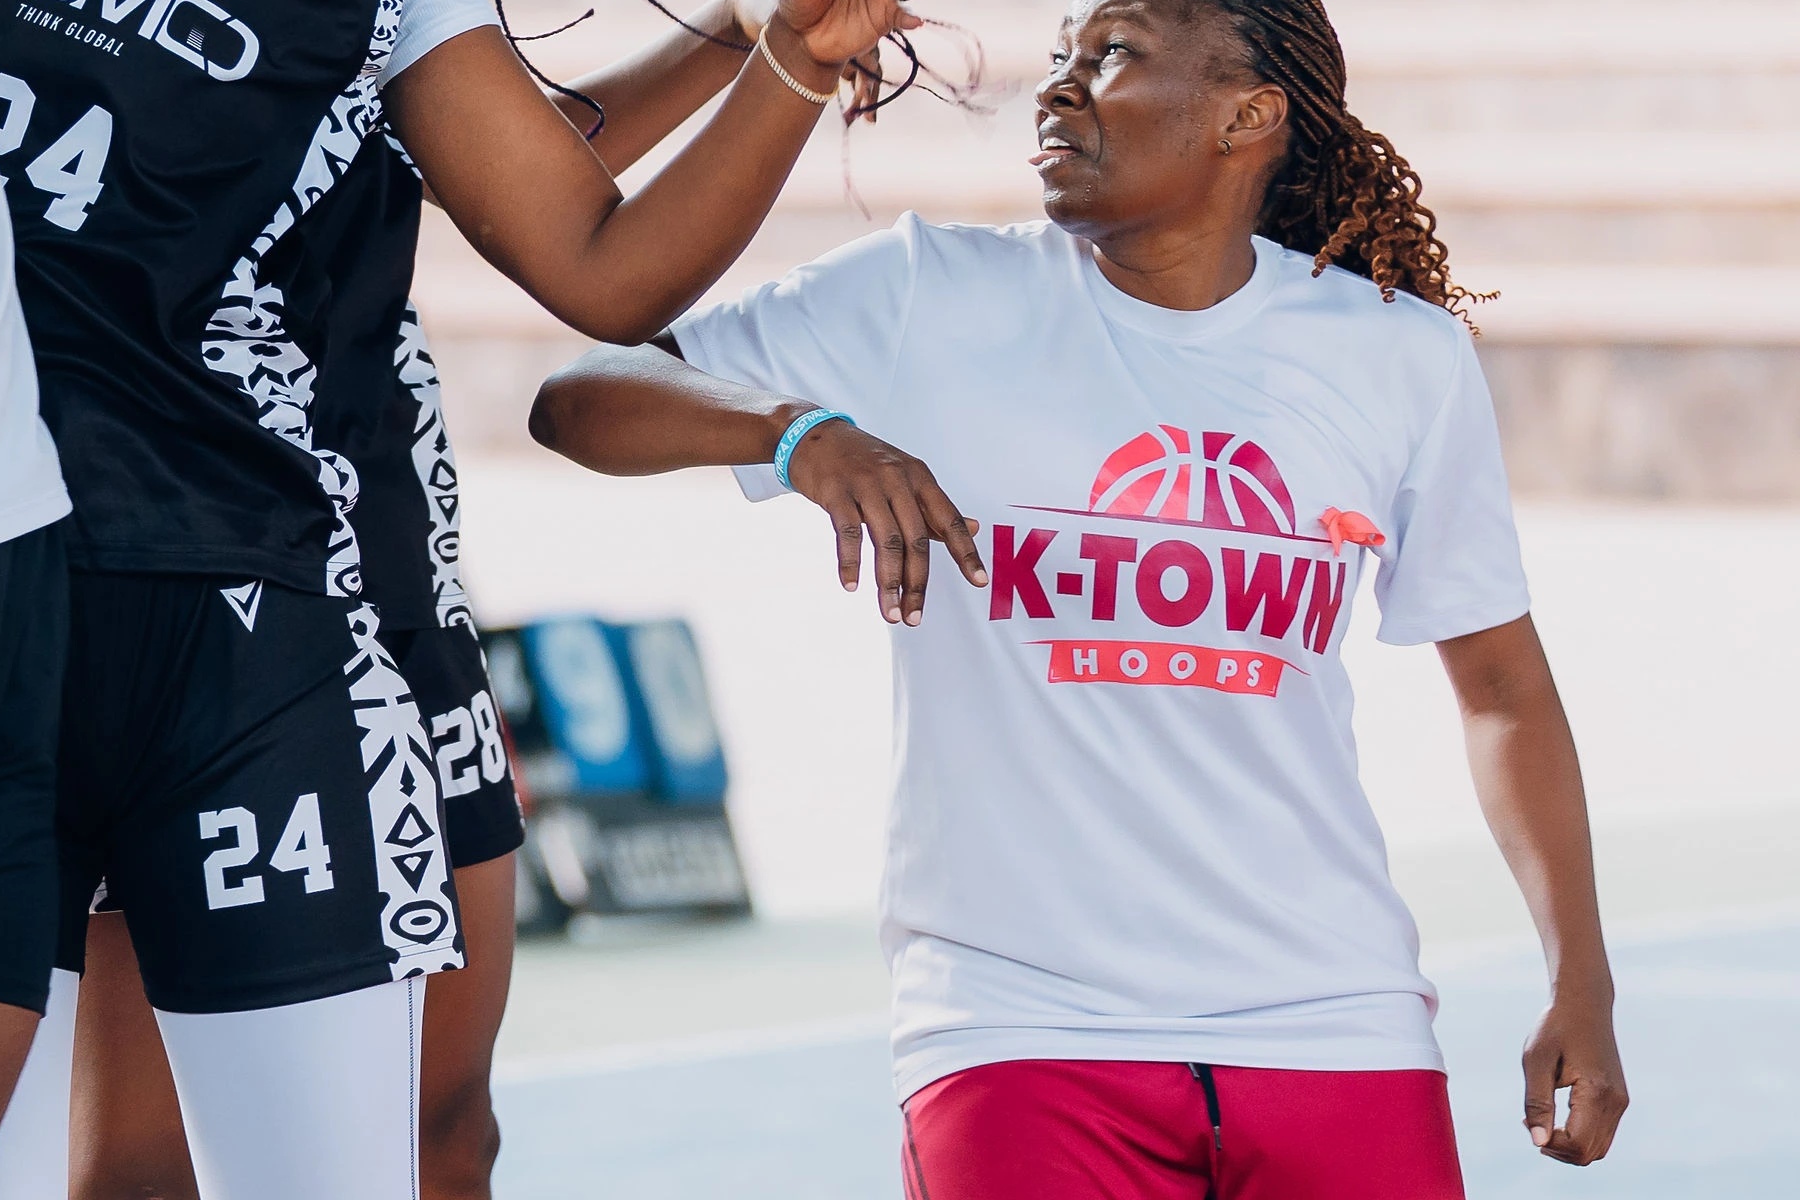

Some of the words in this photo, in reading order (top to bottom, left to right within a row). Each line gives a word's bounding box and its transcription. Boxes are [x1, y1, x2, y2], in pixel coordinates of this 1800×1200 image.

[15, 3, 61, 31] THINK
[65, 22, 125, 57] GLOBAL
[787, 408, 829, 443] FESTIVAL
[988, 524, 1347, 655] K-TOWN
[1071, 648, 1264, 688] HOOPS
[430, 689, 507, 799] 28
[198, 792, 335, 911] 24
